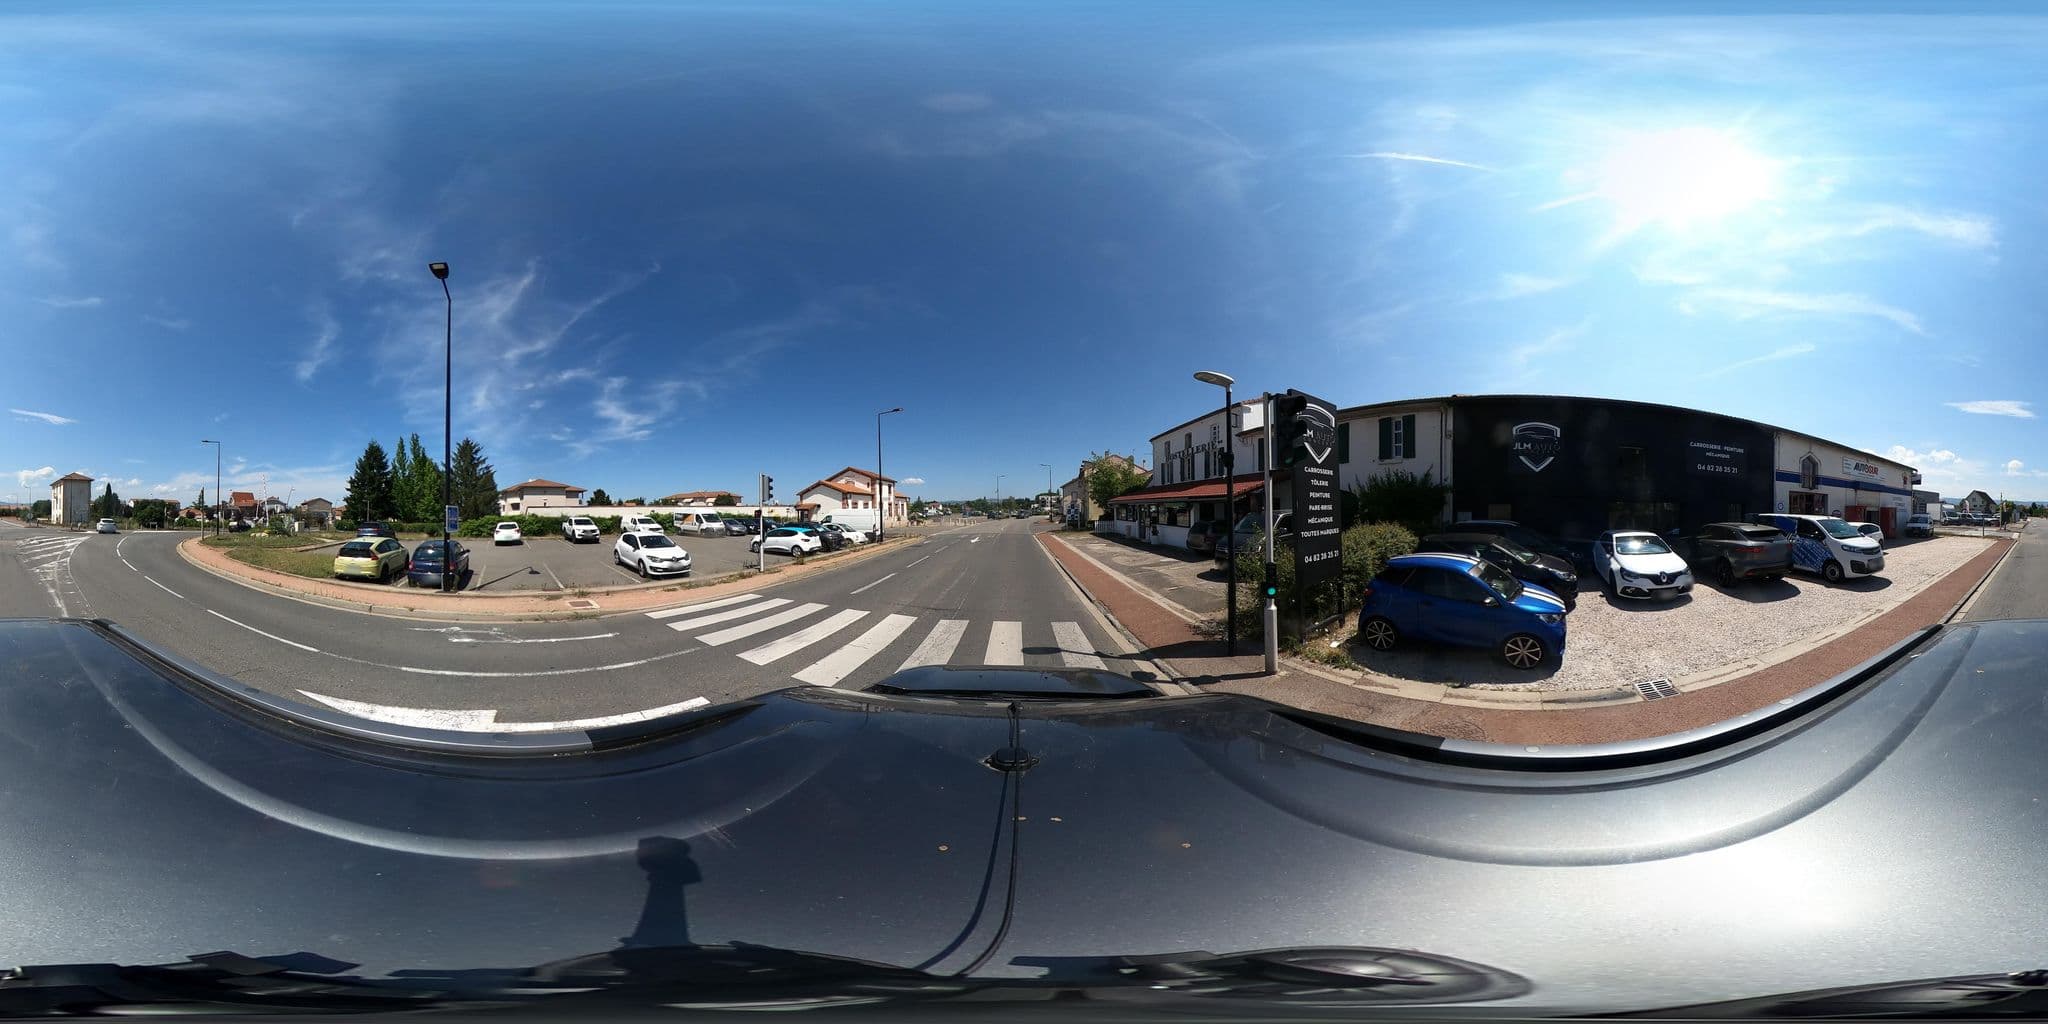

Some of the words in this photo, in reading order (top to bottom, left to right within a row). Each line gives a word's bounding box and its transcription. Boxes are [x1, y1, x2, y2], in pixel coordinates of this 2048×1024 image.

[1513, 442, 1531, 450] JLM
[1690, 442, 1720, 450] CARROSSERIE
[1304, 466, 1333, 475] CARROSSERIE
[1854, 462, 1878, 475] AUTOSUR
[1310, 491, 1330, 499] PEINTURE
[1308, 515, 1333, 524] MÉCANIQUE
[1304, 555, 1312, 563] 04
